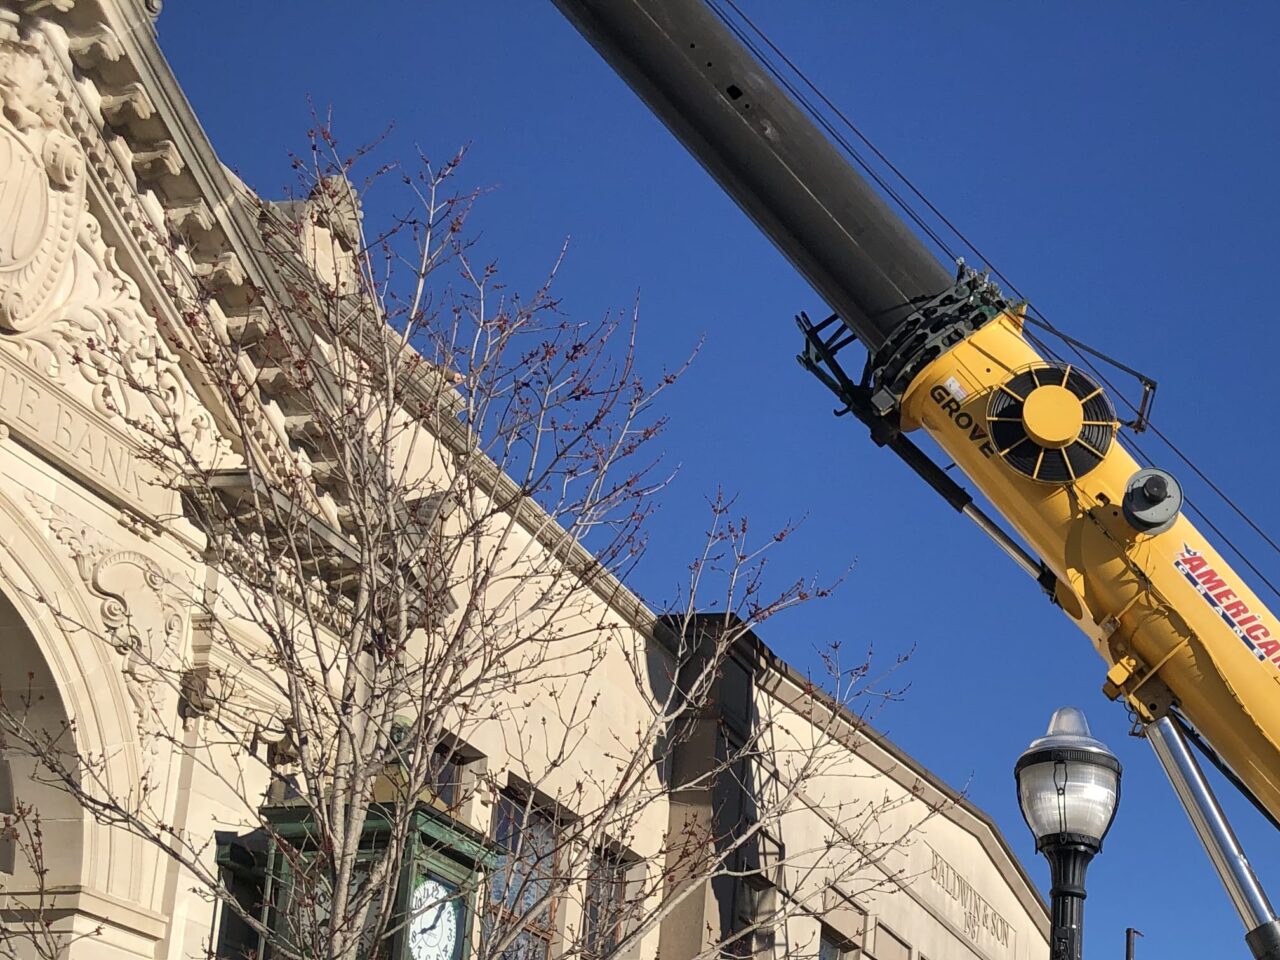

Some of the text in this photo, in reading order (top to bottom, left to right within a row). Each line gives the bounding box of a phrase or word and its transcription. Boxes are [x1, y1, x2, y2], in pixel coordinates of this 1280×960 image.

[52, 403, 145, 502] BANK
[929, 384, 995, 459] GROVE
[1177, 564, 1263, 659] CRANE
[931, 849, 1010, 949] BALDWIN & SON
